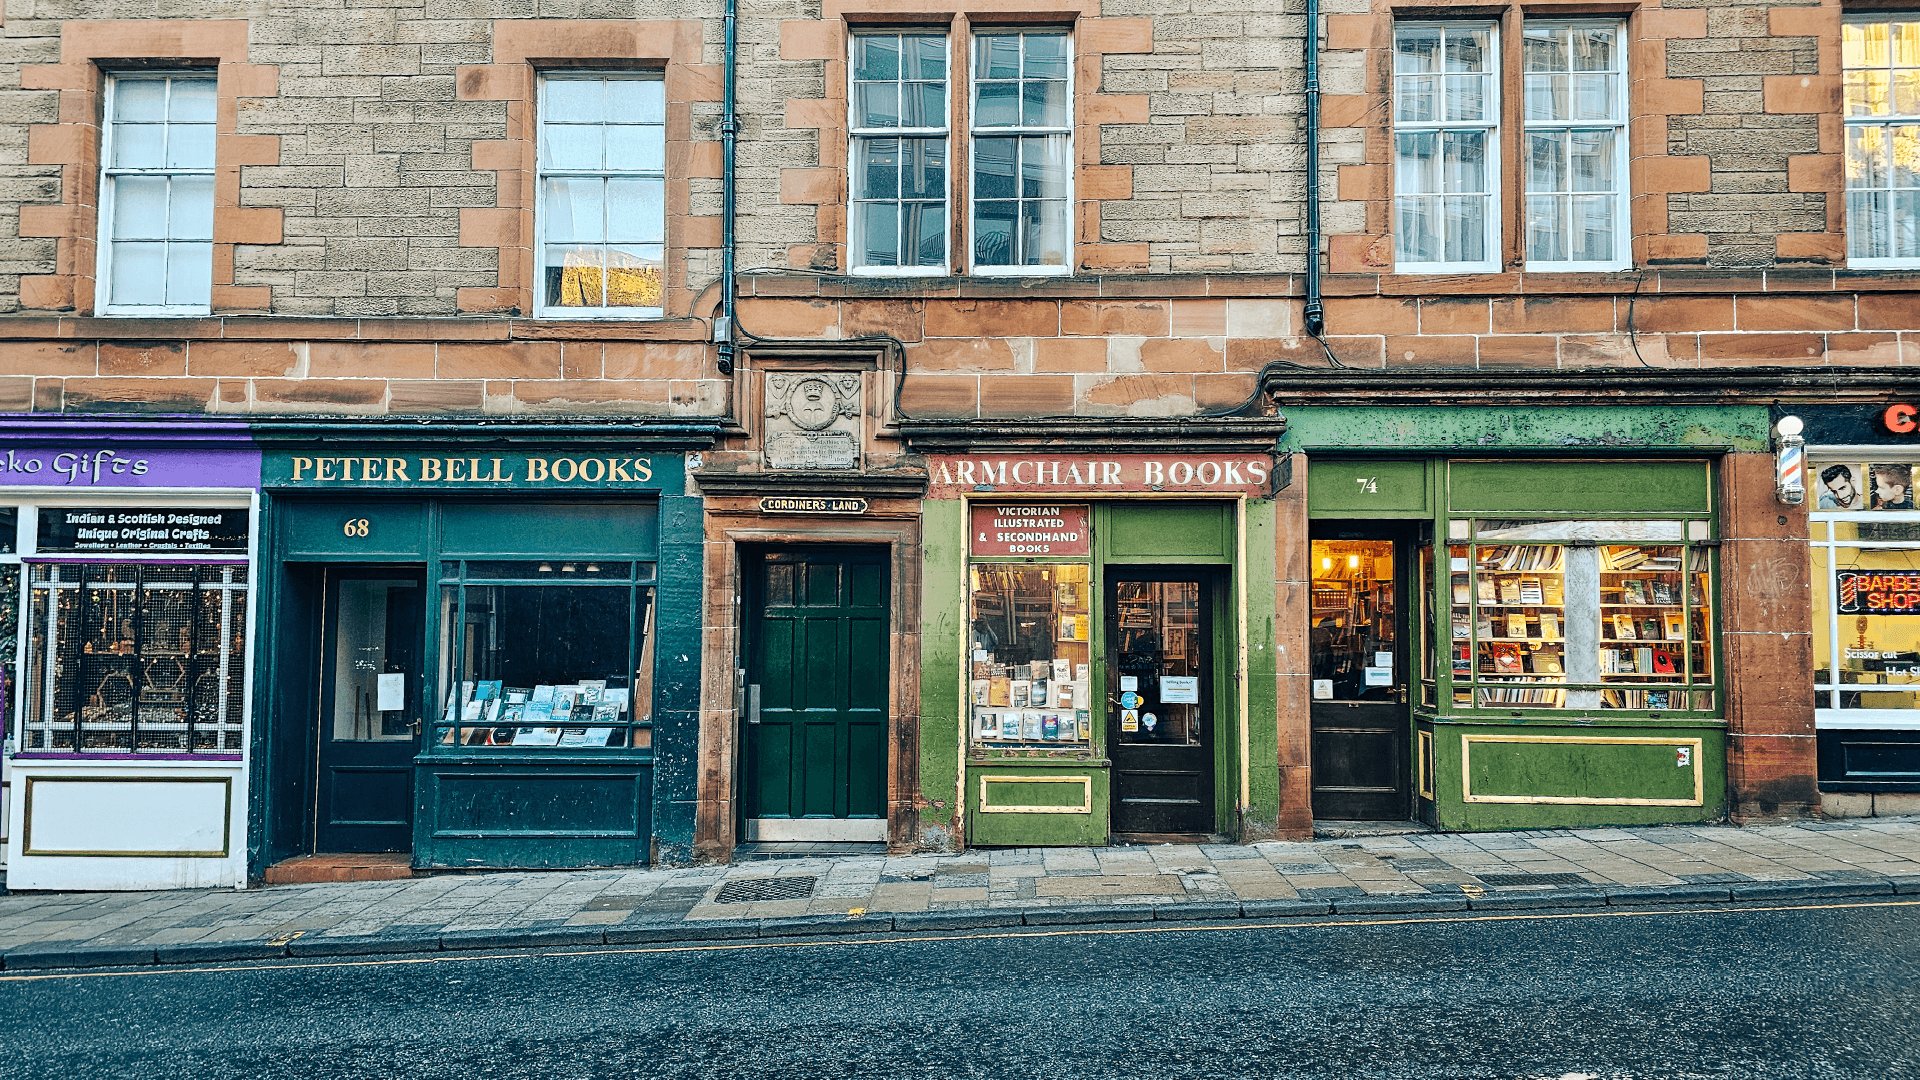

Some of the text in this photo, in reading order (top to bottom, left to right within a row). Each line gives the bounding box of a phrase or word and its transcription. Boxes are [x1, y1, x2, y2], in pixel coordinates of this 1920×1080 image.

[1884, 404, 1920, 433] C
[52, 449, 149, 484] Gifts
[290, 456, 653, 482] PETER BELL BOOKS
[930, 460, 1123, 487] ARMCHAIR
[1143, 460, 1269, 486] BOOKS
[1356, 476, 1378, 494] 74
[832, 501, 859, 511] LAND
[997, 507, 1060, 516] VICTORIAN
[66, 513, 222, 525] Indian & Scottish Designed
[994, 518, 1065, 528] ILLUSTRATED
[344, 518, 369, 537] 68
[77, 528, 210, 540] Unique Original Crafts
[978, 532, 1078, 542] & SECONDHAND
[1009, 544, 1050, 553] BOOKS
[1844, 647, 1898, 659] Scissor cut
[1885, 666, 1906, 676] Hot
